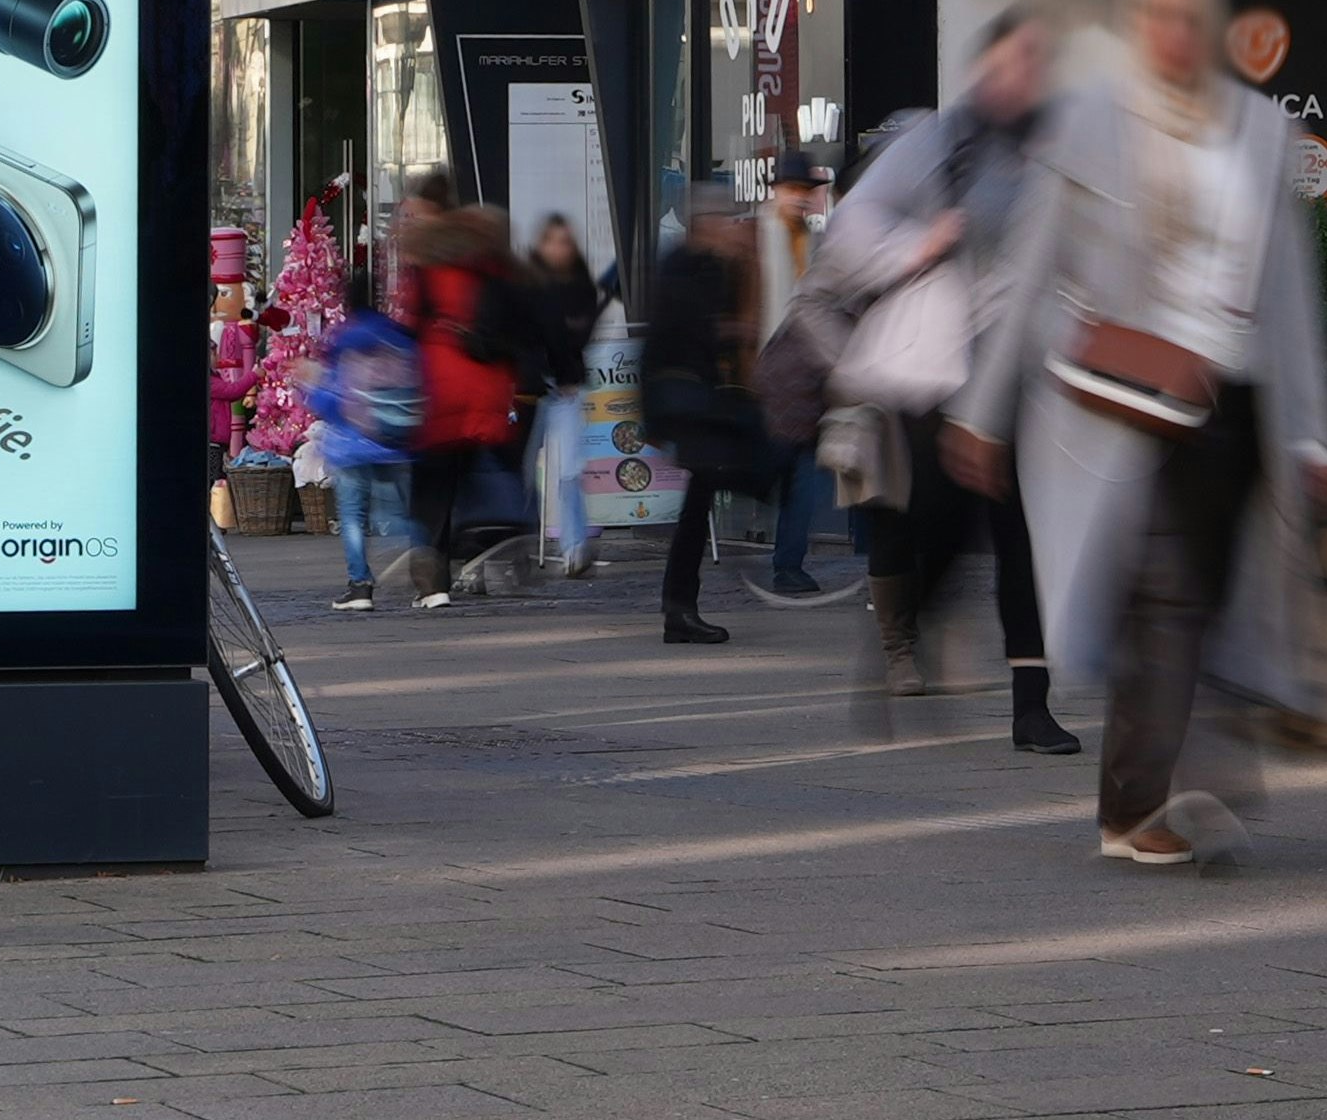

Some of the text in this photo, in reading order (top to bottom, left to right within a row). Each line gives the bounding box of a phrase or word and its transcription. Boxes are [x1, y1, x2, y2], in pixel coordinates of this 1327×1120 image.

[478, 55, 567, 66] MARIAHILFER
[597, 368, 639, 386] Men
[2, 520, 64, 532] Powered by
